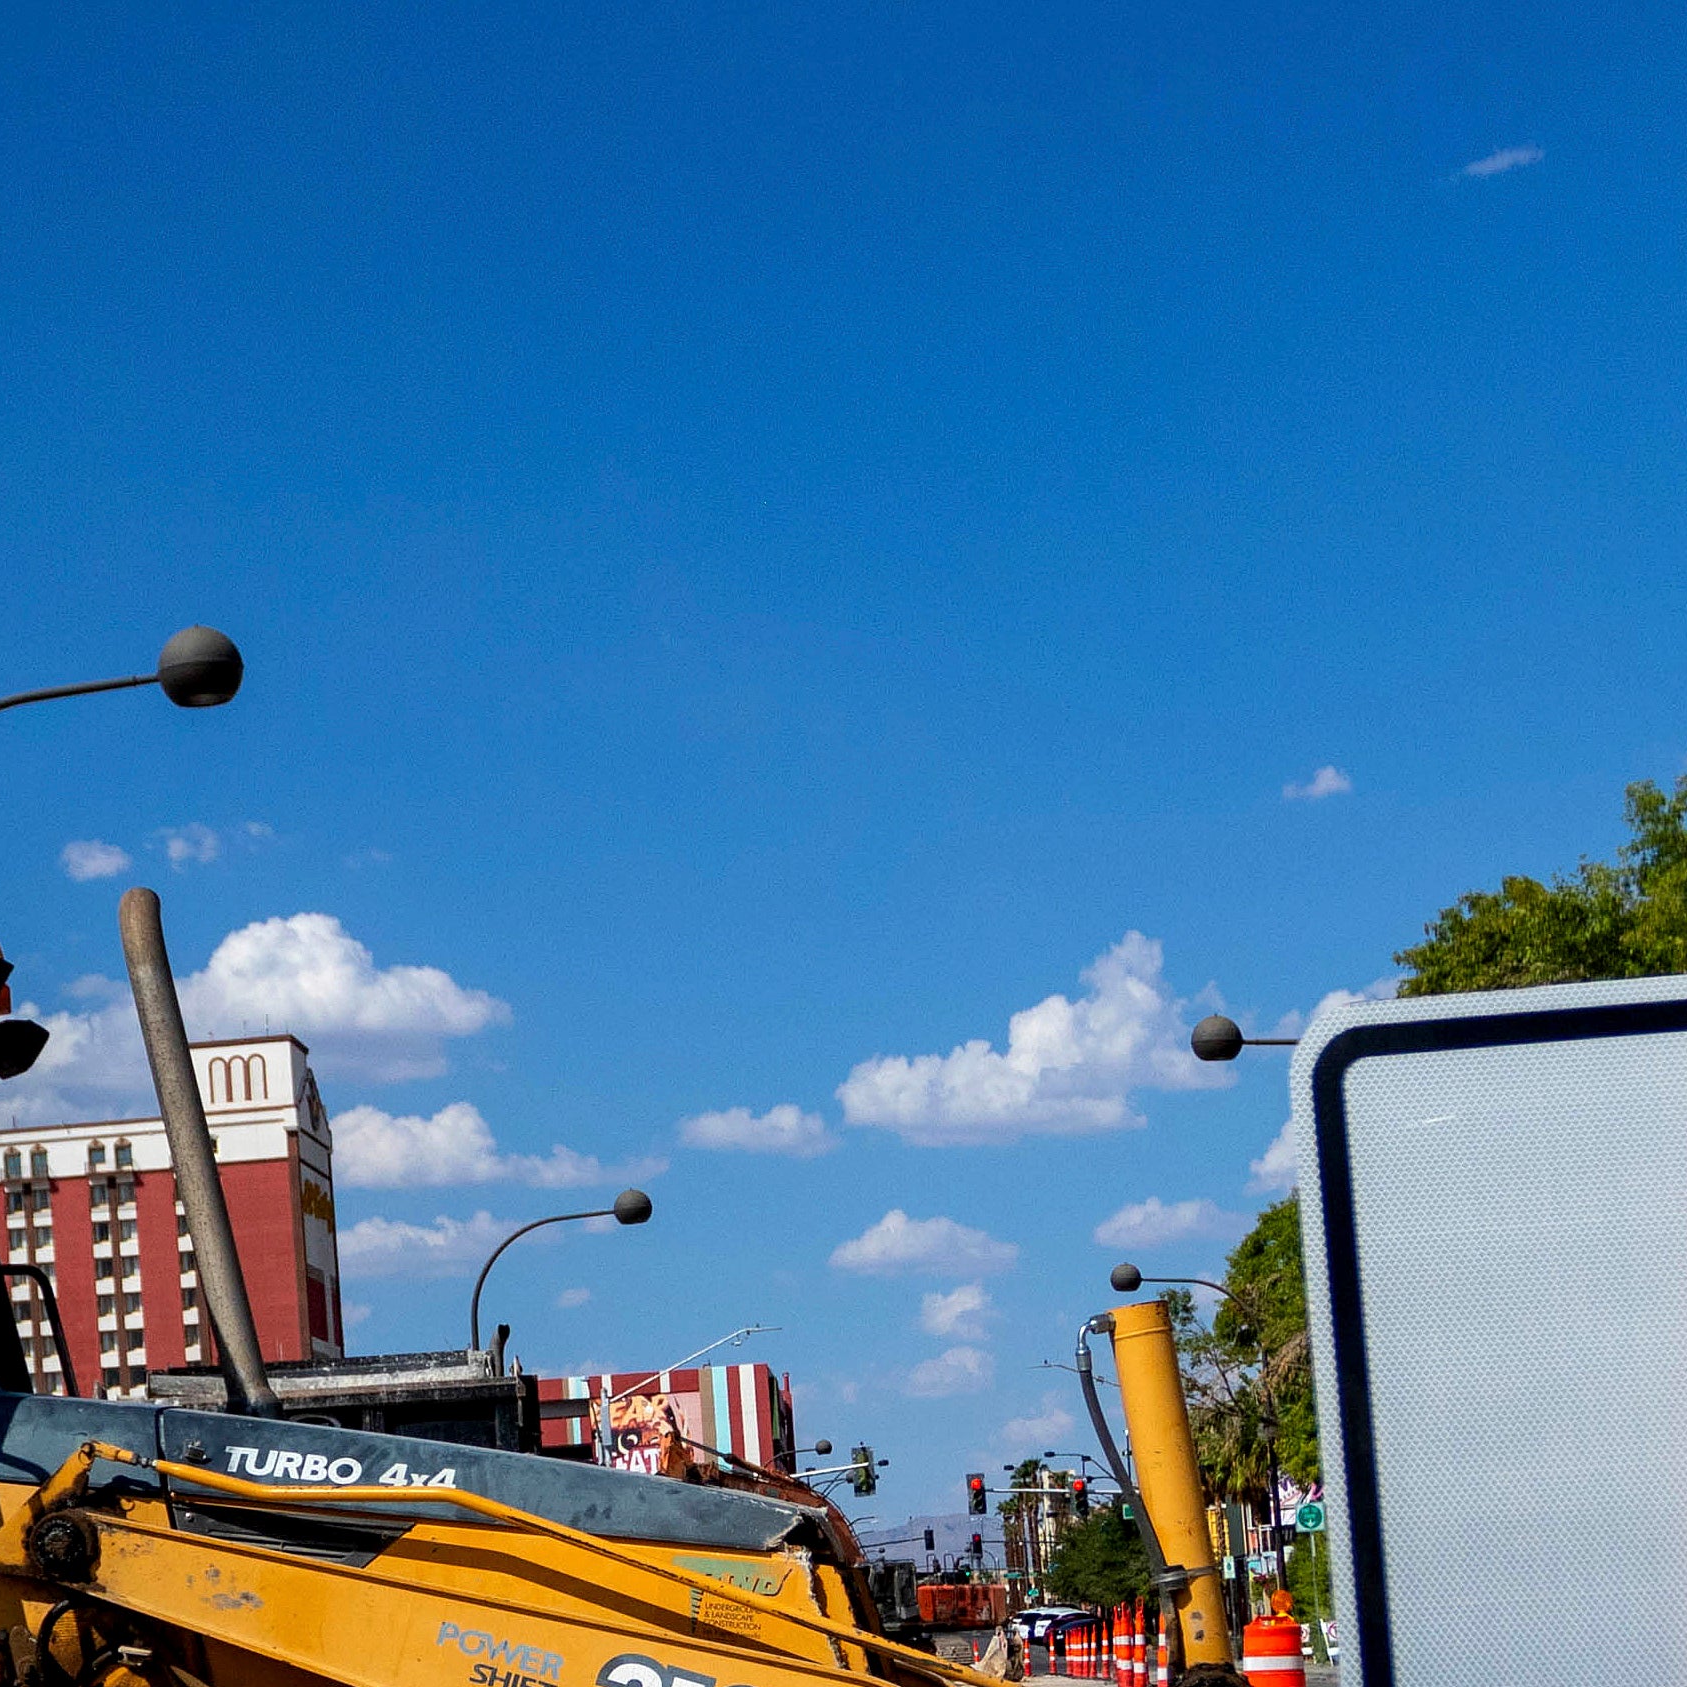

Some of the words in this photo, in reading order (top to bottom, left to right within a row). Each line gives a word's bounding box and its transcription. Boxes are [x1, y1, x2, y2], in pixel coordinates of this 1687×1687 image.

[225, 1446, 362, 1485] TURBO
[379, 1463, 456, 1489] 4x4
[436, 1621, 565, 1680] POWER
